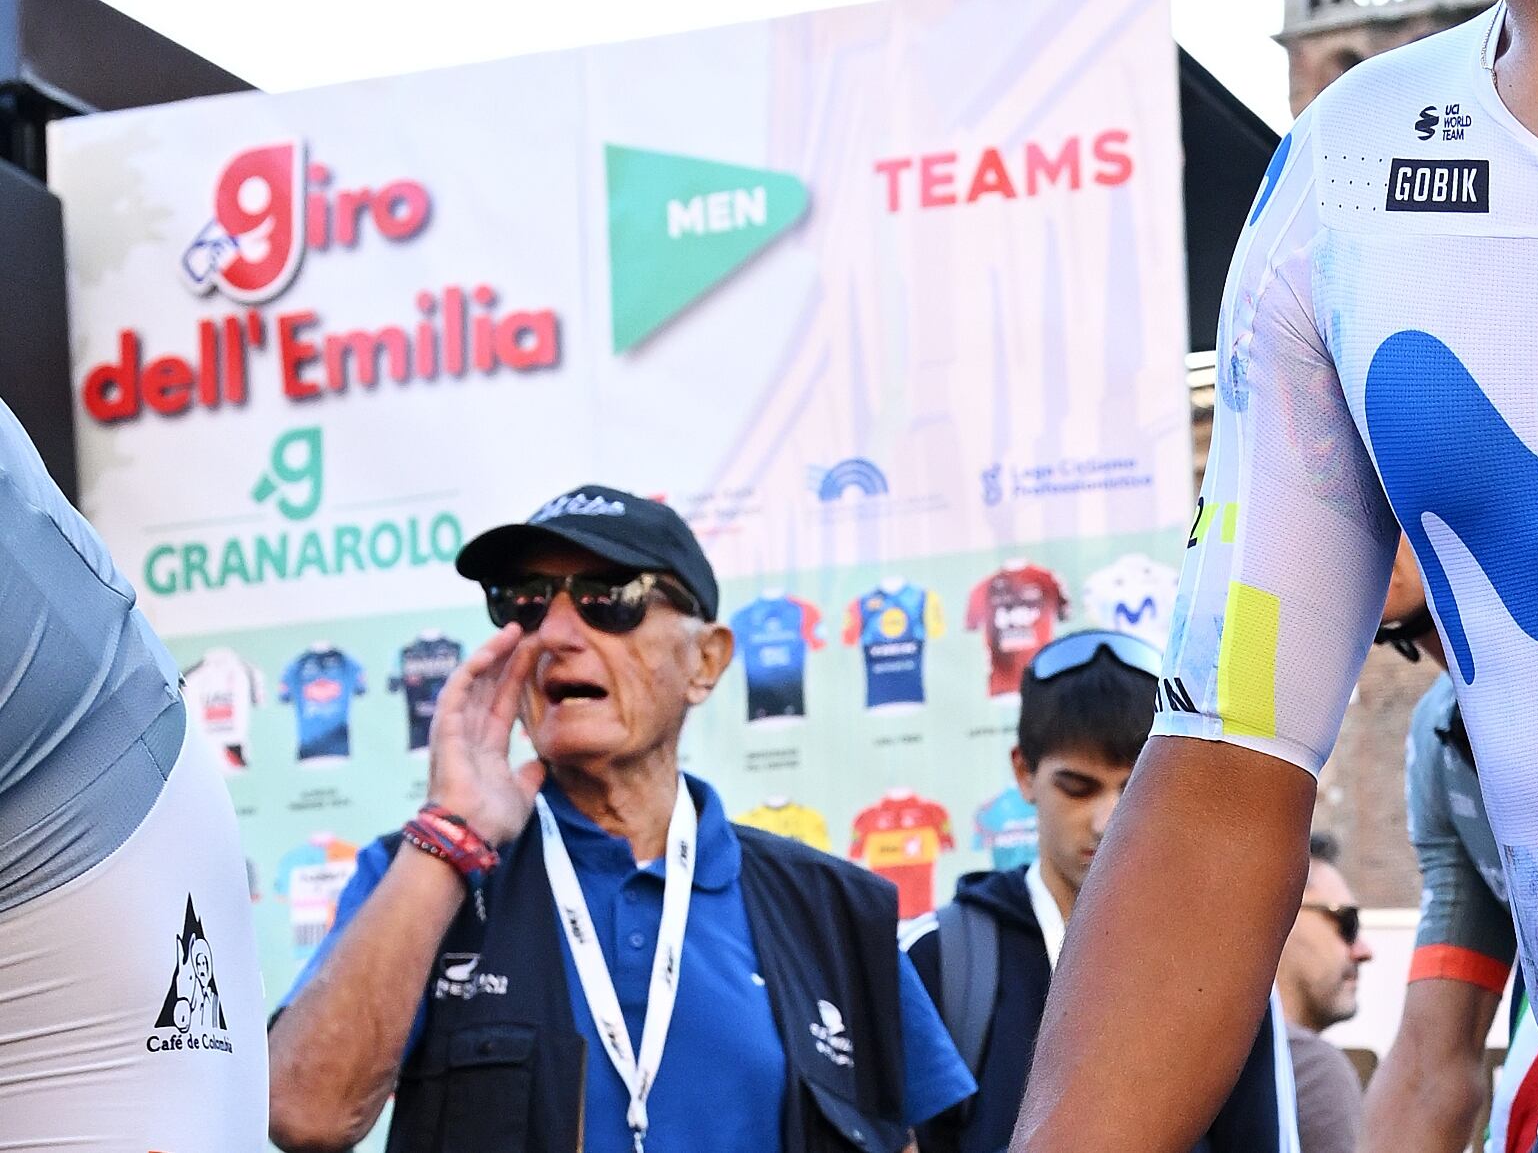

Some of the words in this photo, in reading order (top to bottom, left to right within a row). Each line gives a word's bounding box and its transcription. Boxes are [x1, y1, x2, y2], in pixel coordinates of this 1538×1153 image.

[1443, 114, 1472, 128] WORLD
[1445, 103, 1460, 115] UCI
[1442, 128, 1464, 141] TEAM
[873, 130, 1134, 213] TEAMS
[1394, 166, 1478, 202] GOBIK
[666, 186, 769, 238] MEN
[82, 283, 562, 423] dell'Emilia
[144, 511, 463, 595] GRANAROLO
[146, 1034, 184, 1053] Café
[186, 1033, 200, 1050] de
